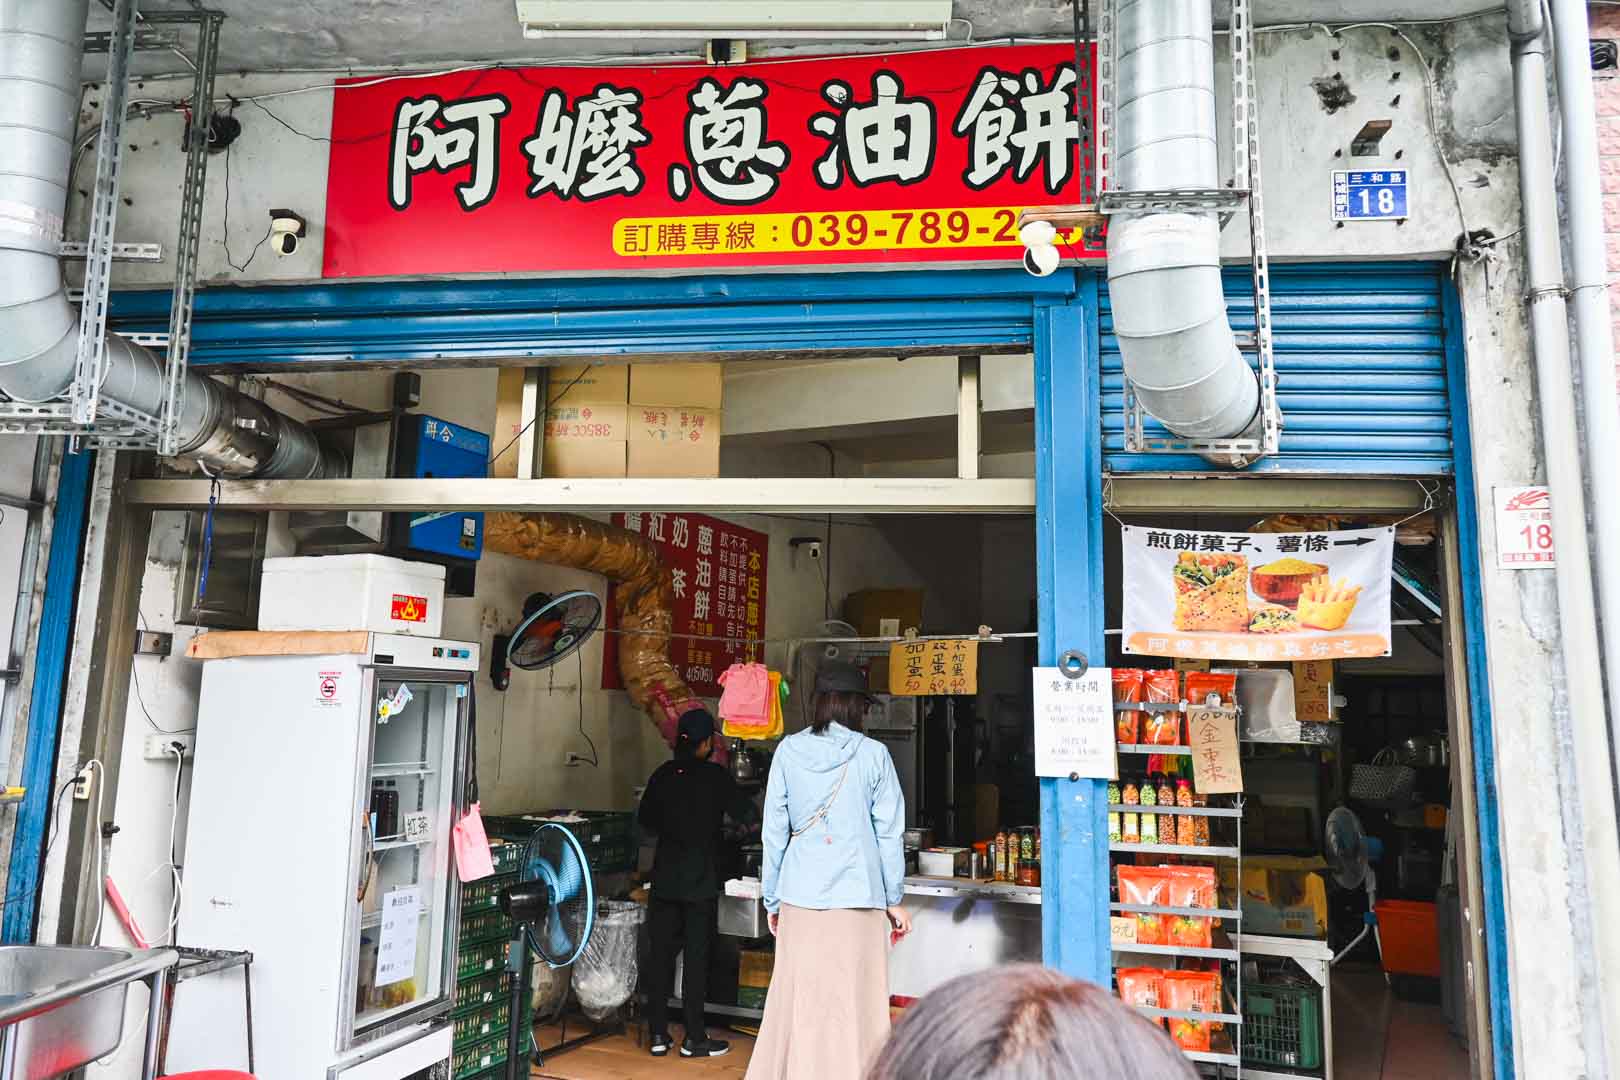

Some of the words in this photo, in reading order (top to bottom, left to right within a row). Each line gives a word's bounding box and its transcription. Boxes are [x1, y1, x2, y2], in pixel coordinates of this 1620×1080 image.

[391, 65, 1081, 208] 阿嬤蔥油餅
[1351, 172, 1402, 184] 三和路
[1358, 188, 1394, 215] 18
[1520, 524, 1552, 550] 18
[407, 816, 430, 836] 紅茶
